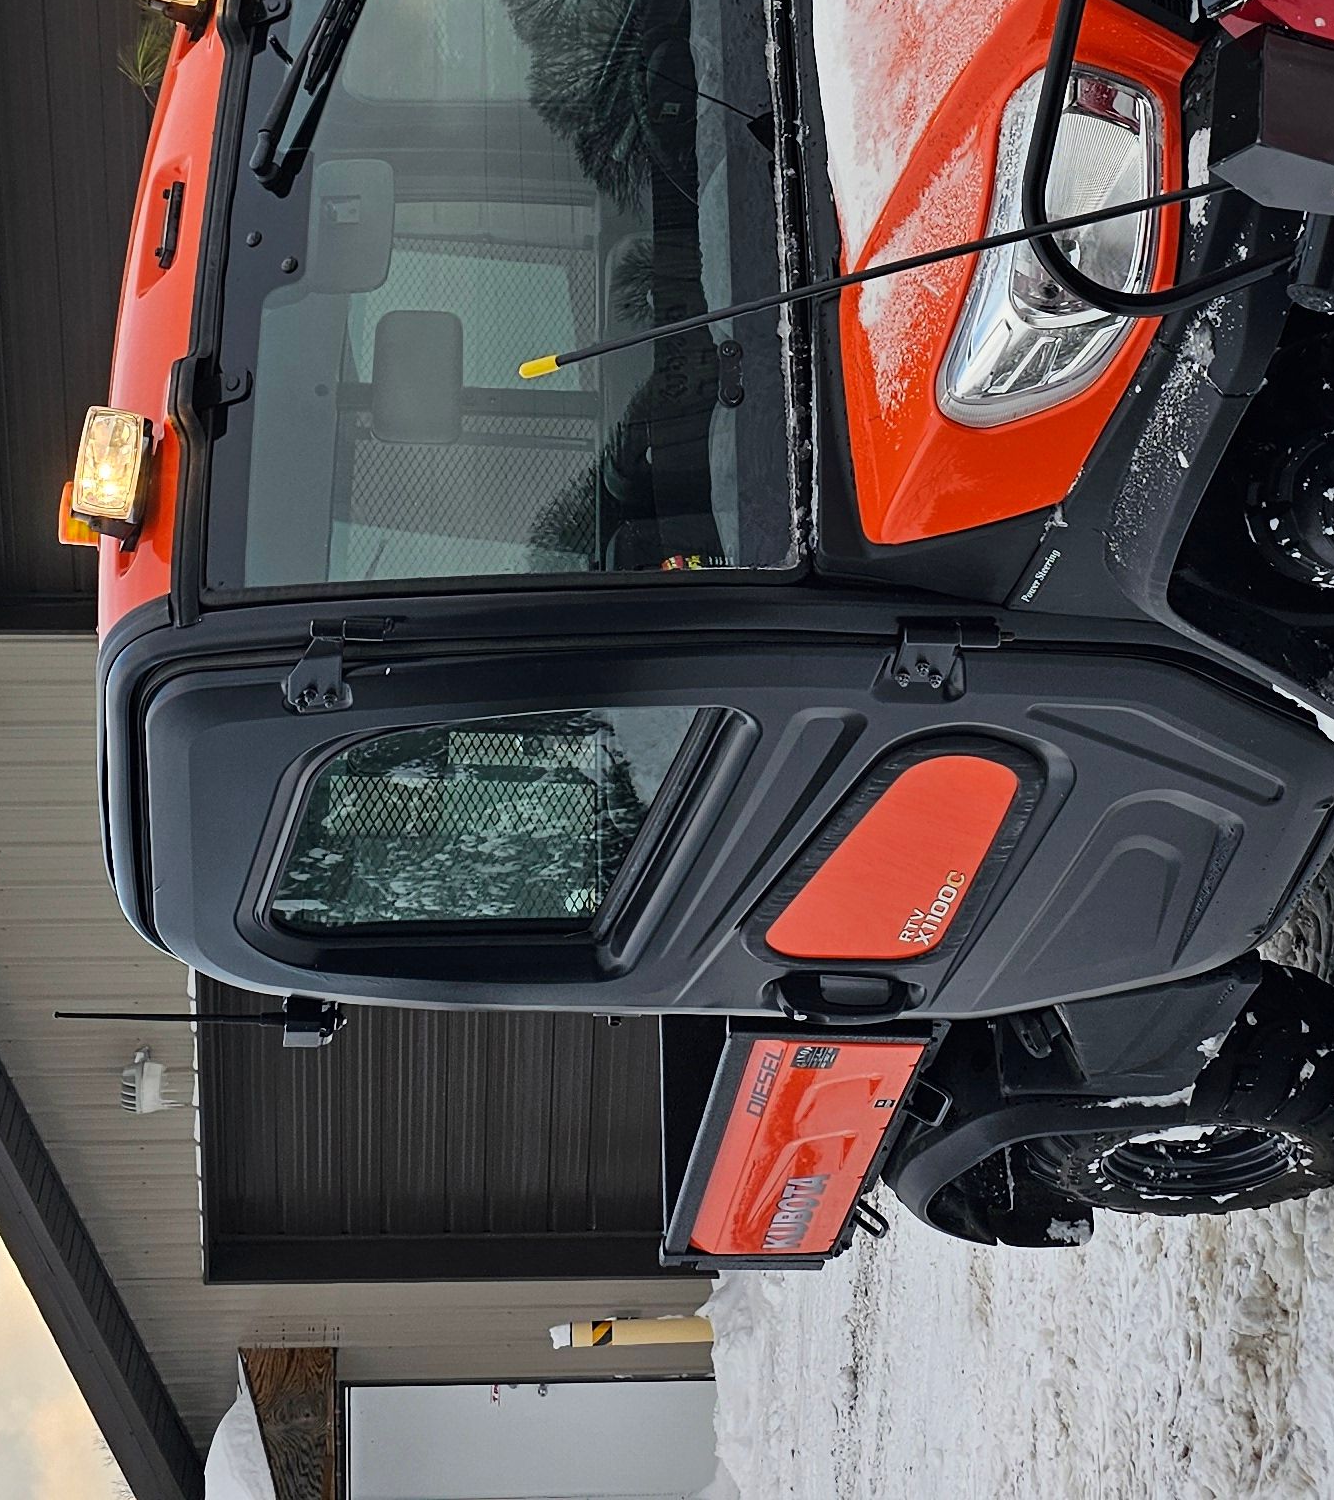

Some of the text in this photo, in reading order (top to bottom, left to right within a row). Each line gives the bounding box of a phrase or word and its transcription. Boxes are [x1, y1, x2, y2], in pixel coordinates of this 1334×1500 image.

[1020, 549, 1061, 602] Power Steering
[898, 908, 926, 943] RTV
[913, 870, 965, 947] X1100C
[745, 1048, 784, 1118] DIESEL
[761, 1173, 831, 1250] KUBOTA
